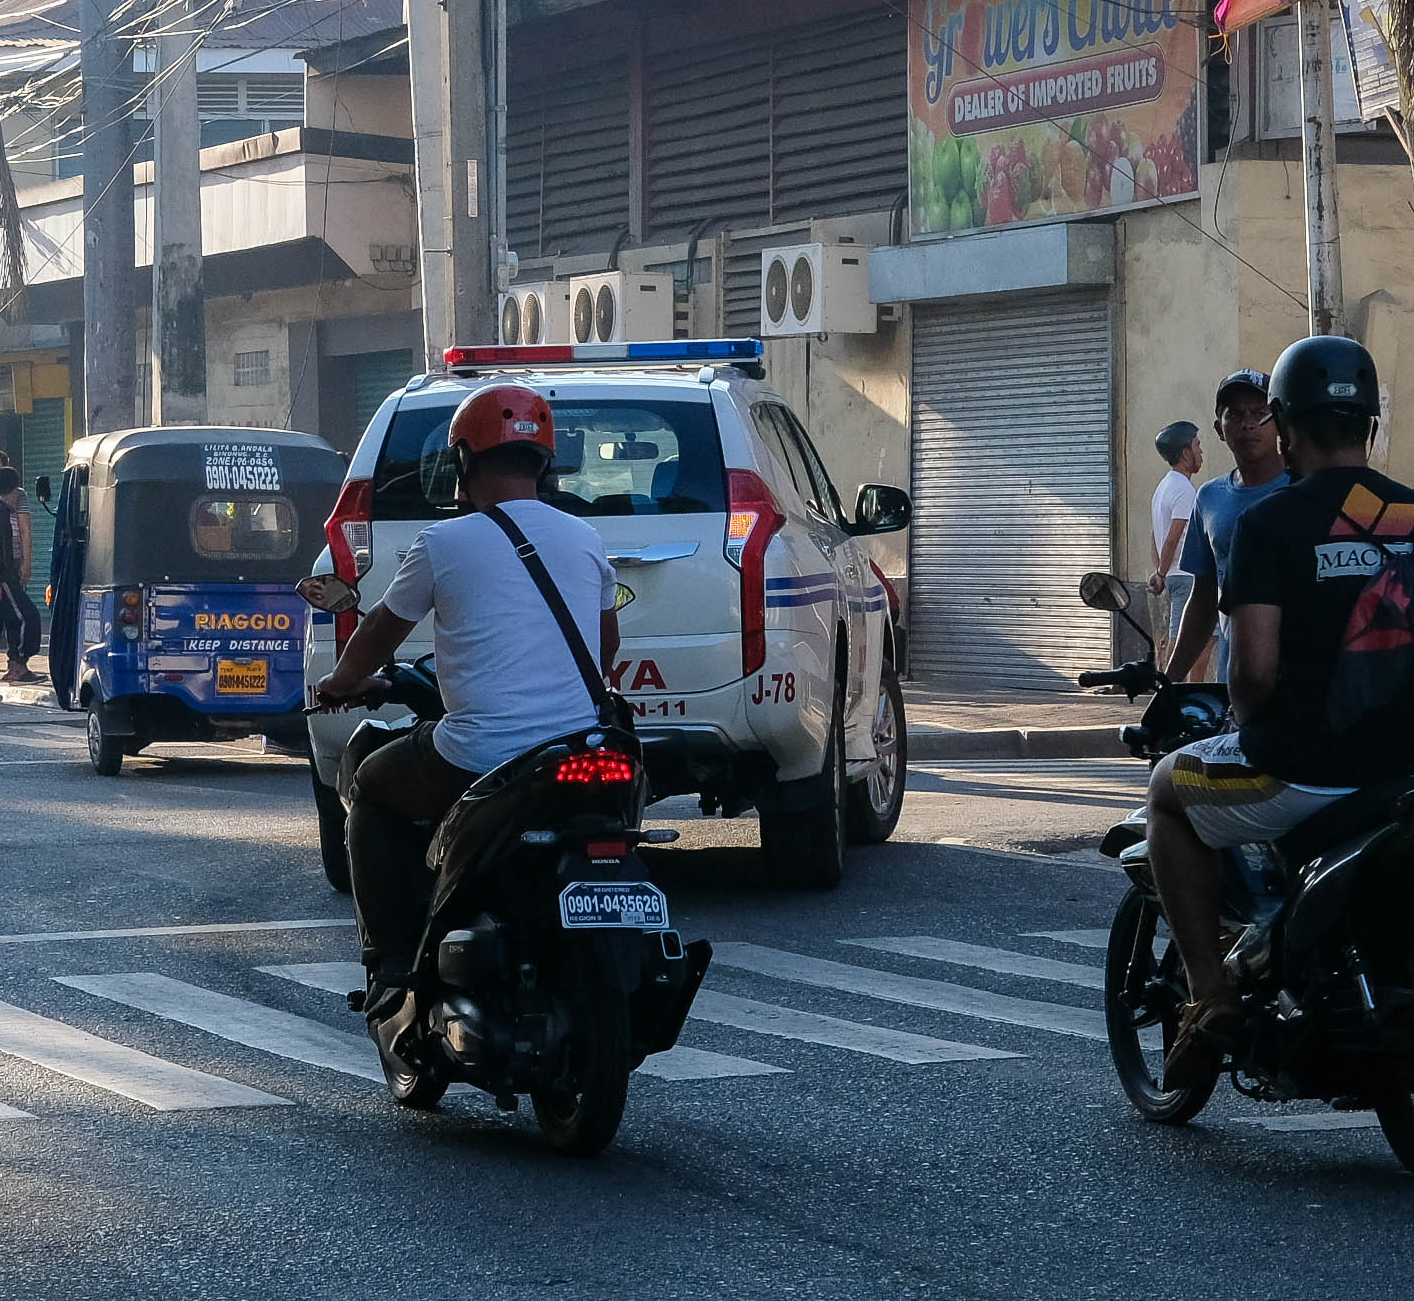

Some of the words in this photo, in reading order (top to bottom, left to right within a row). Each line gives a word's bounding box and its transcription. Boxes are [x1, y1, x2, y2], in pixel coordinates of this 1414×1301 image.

[954, 88, 1004, 123] DEALER
[1007, 83, 1026, 112] OF
[1029, 69, 1103, 108] IMPORTED
[1106, 56, 1157, 101] FRUITS
[194, 613, 291, 630] PIAGGIO
[188, 640, 221, 651] KEEP
[229, 640, 290, 651] DISTANCE
[751, 672, 796, 706] J-78
[567, 894, 660, 914] 0901-0435626
